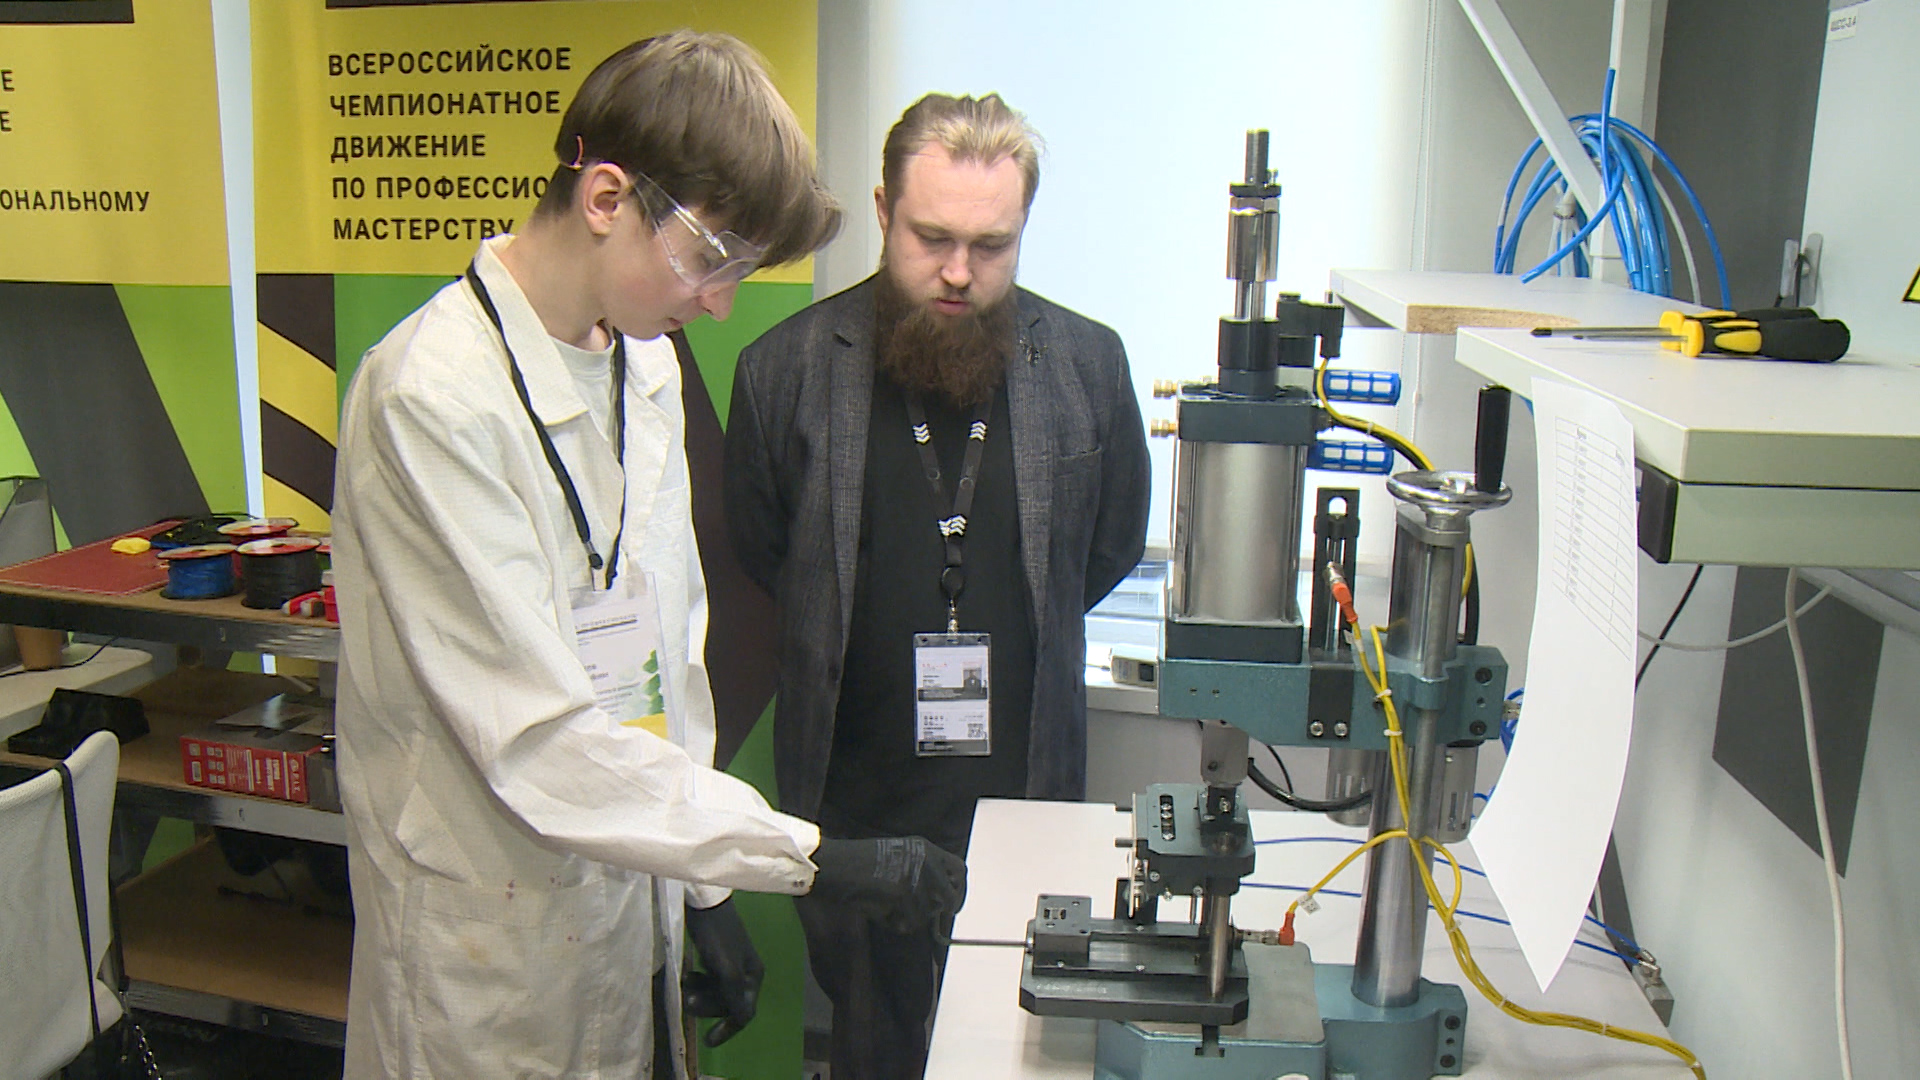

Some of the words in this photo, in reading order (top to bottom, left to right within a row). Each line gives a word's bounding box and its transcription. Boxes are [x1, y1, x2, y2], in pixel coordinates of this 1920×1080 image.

[328, 43, 571, 76] ВСЕРОССИЙСКОЕ
[329, 91, 561, 117] ЧЕМПИОНАТНОЕ
[330, 134, 486, 163] ДВИЖЕНИЕ
[332, 177, 365, 199] ПО
[0, 189, 150, 212] ОНАЛЬНОМУ
[333, 218, 514, 240] МАСТЕРСТВУ
